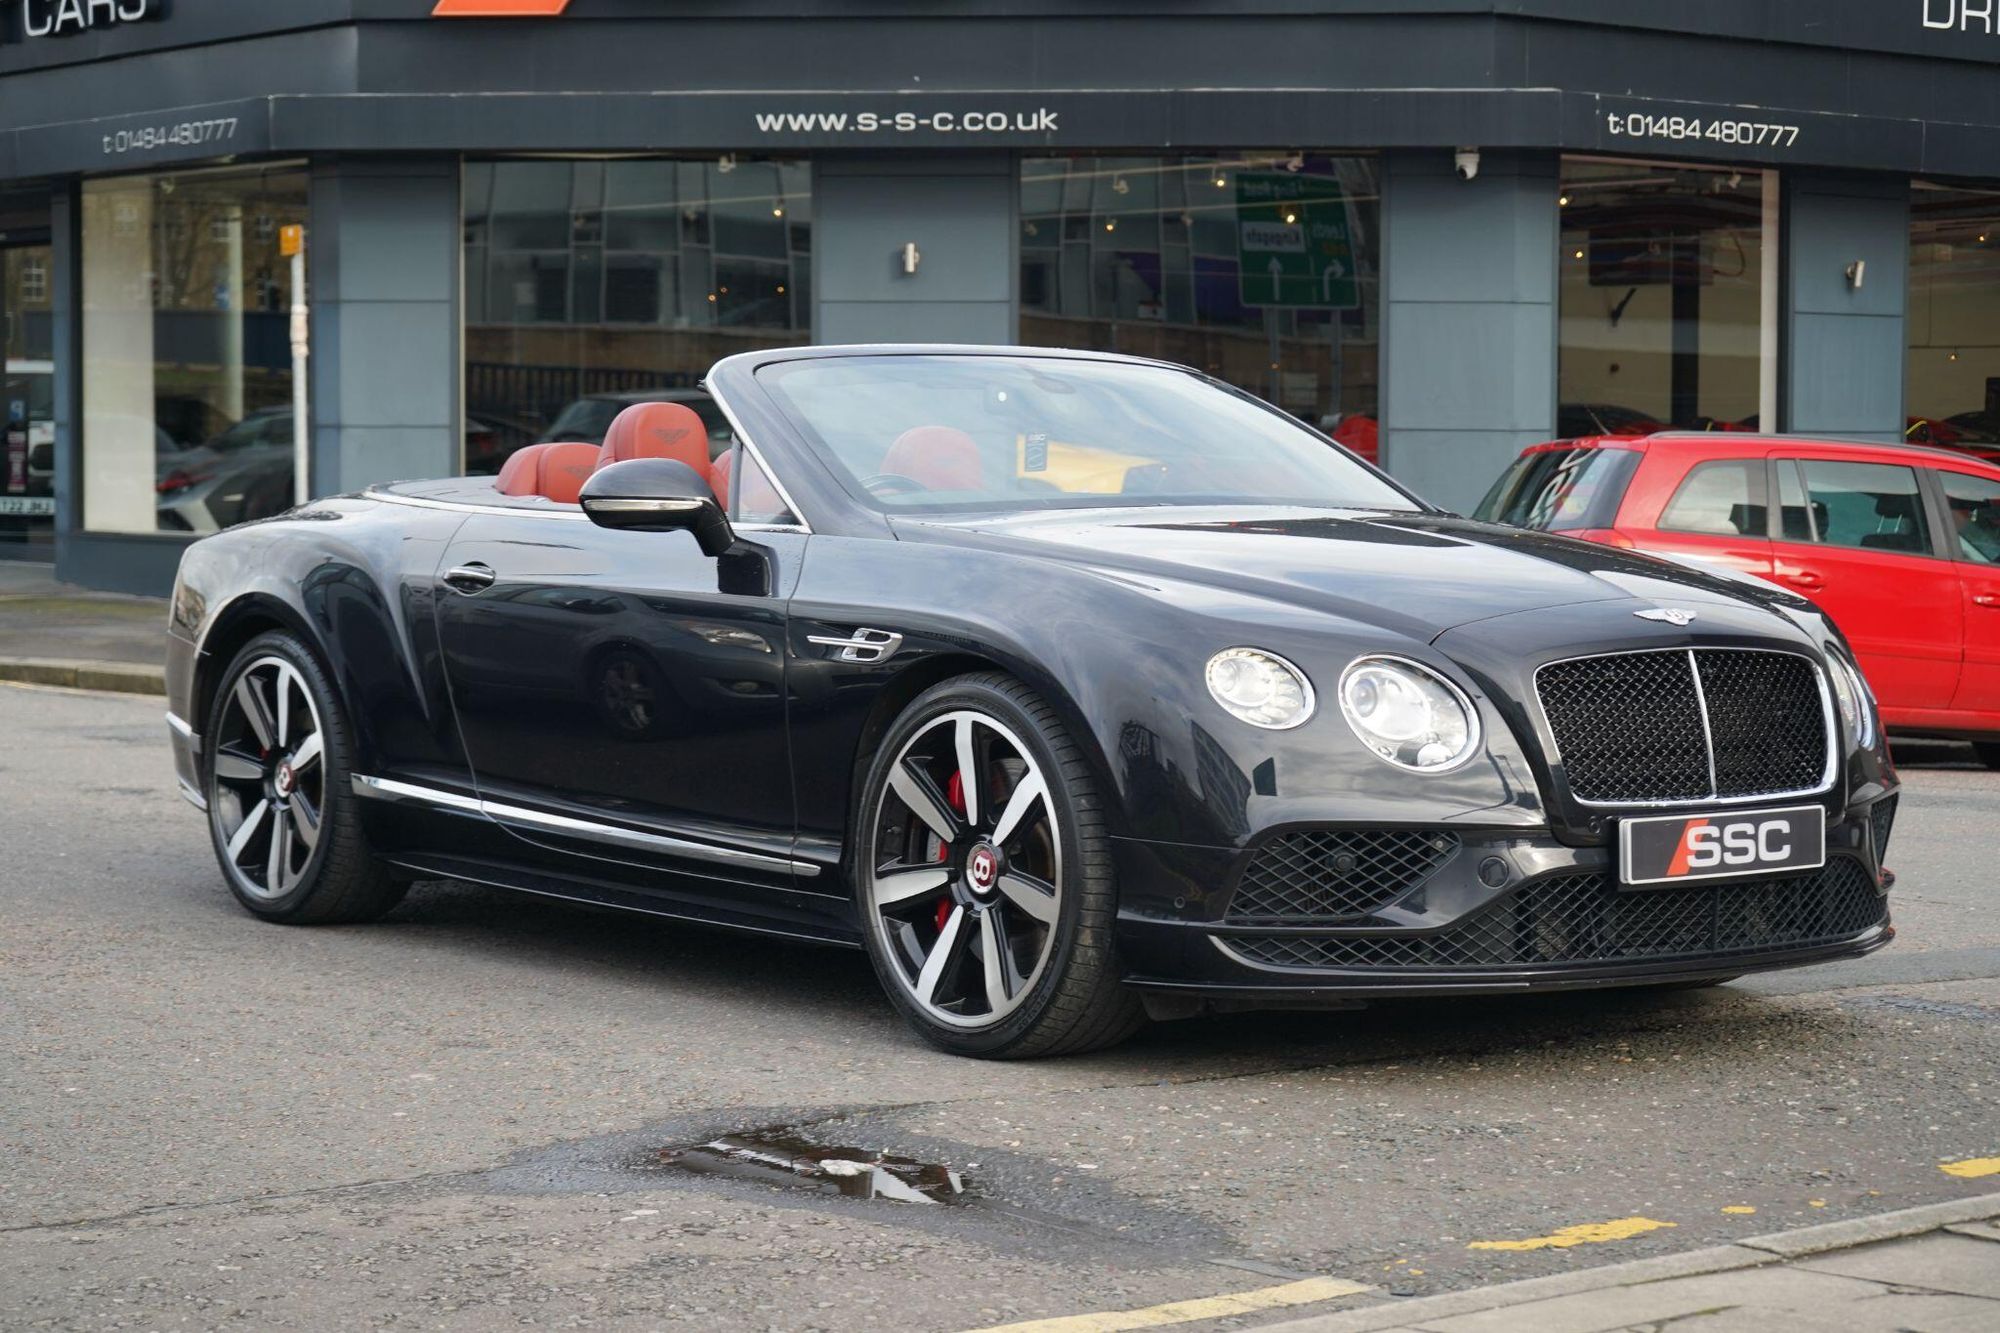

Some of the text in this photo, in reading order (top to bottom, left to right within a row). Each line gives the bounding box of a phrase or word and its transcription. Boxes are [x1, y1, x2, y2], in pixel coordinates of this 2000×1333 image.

[1922, 0, 2000, 34] DR
[168, 117, 239, 147] 480777
[755, 108, 1059, 132] www.s-s-c.co.uk
[1704, 120, 1800, 148] 480777
[1686, 819, 1791, 868] SSC
